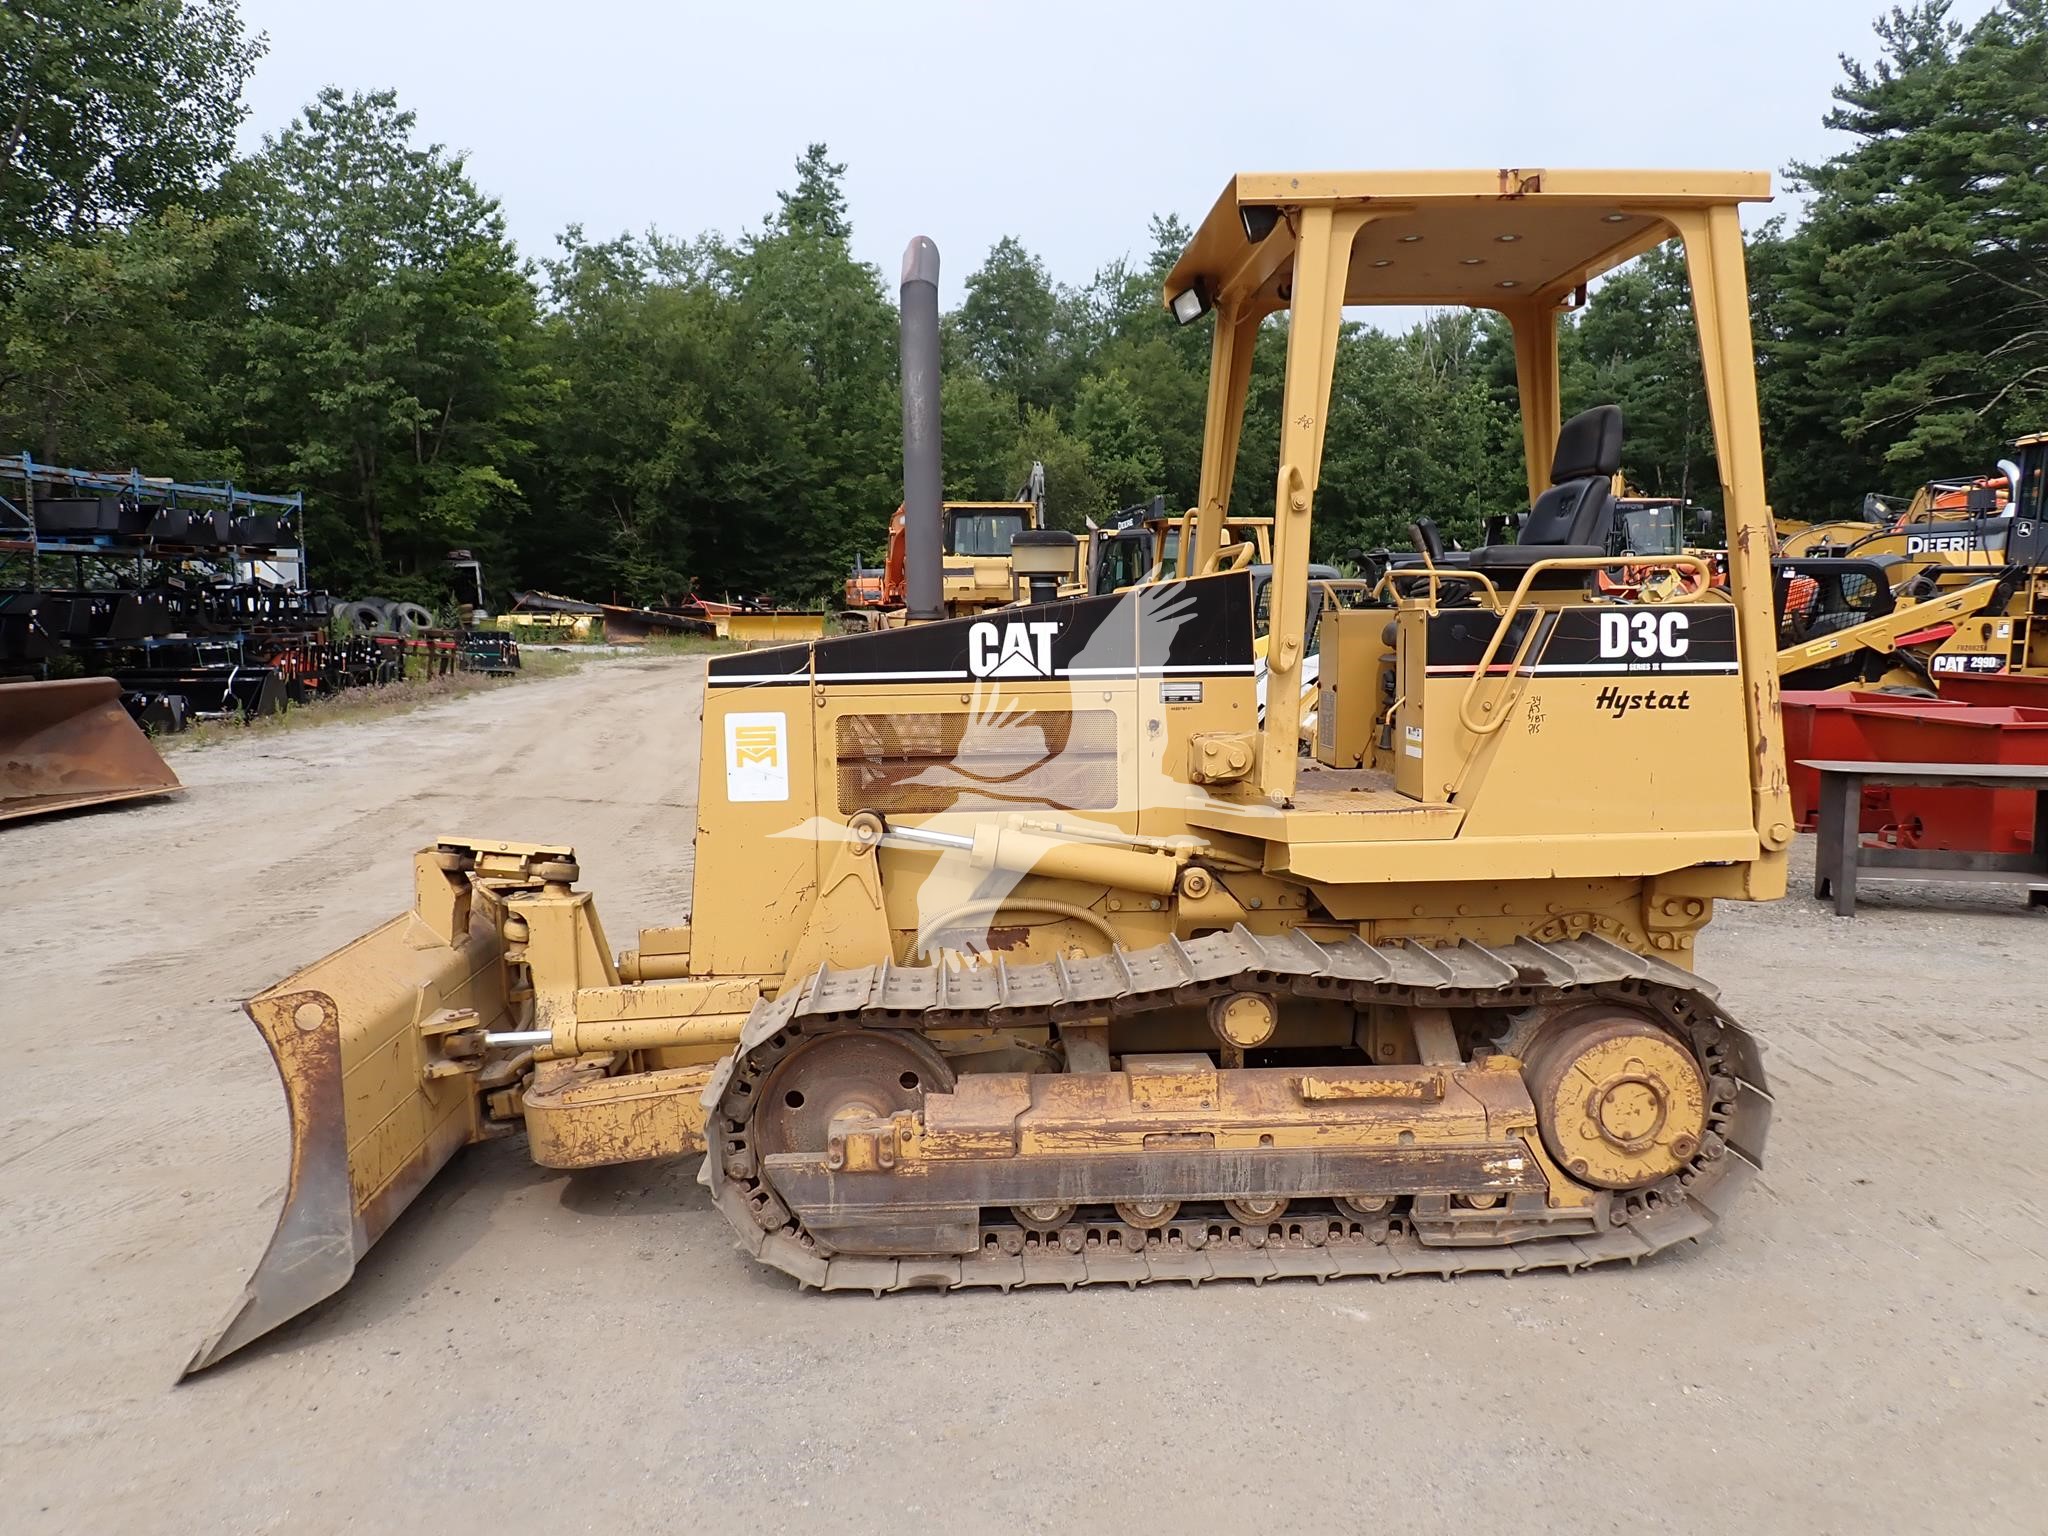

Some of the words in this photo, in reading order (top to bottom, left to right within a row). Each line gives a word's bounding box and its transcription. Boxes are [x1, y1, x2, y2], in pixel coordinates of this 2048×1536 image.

[1908, 537, 1975, 554] DEERE
[969, 622, 1059, 677] CAT
[1600, 612, 1689, 658] D3C
[1934, 656, 1967, 672] CAT
[1596, 687, 1690, 718] Hystat
